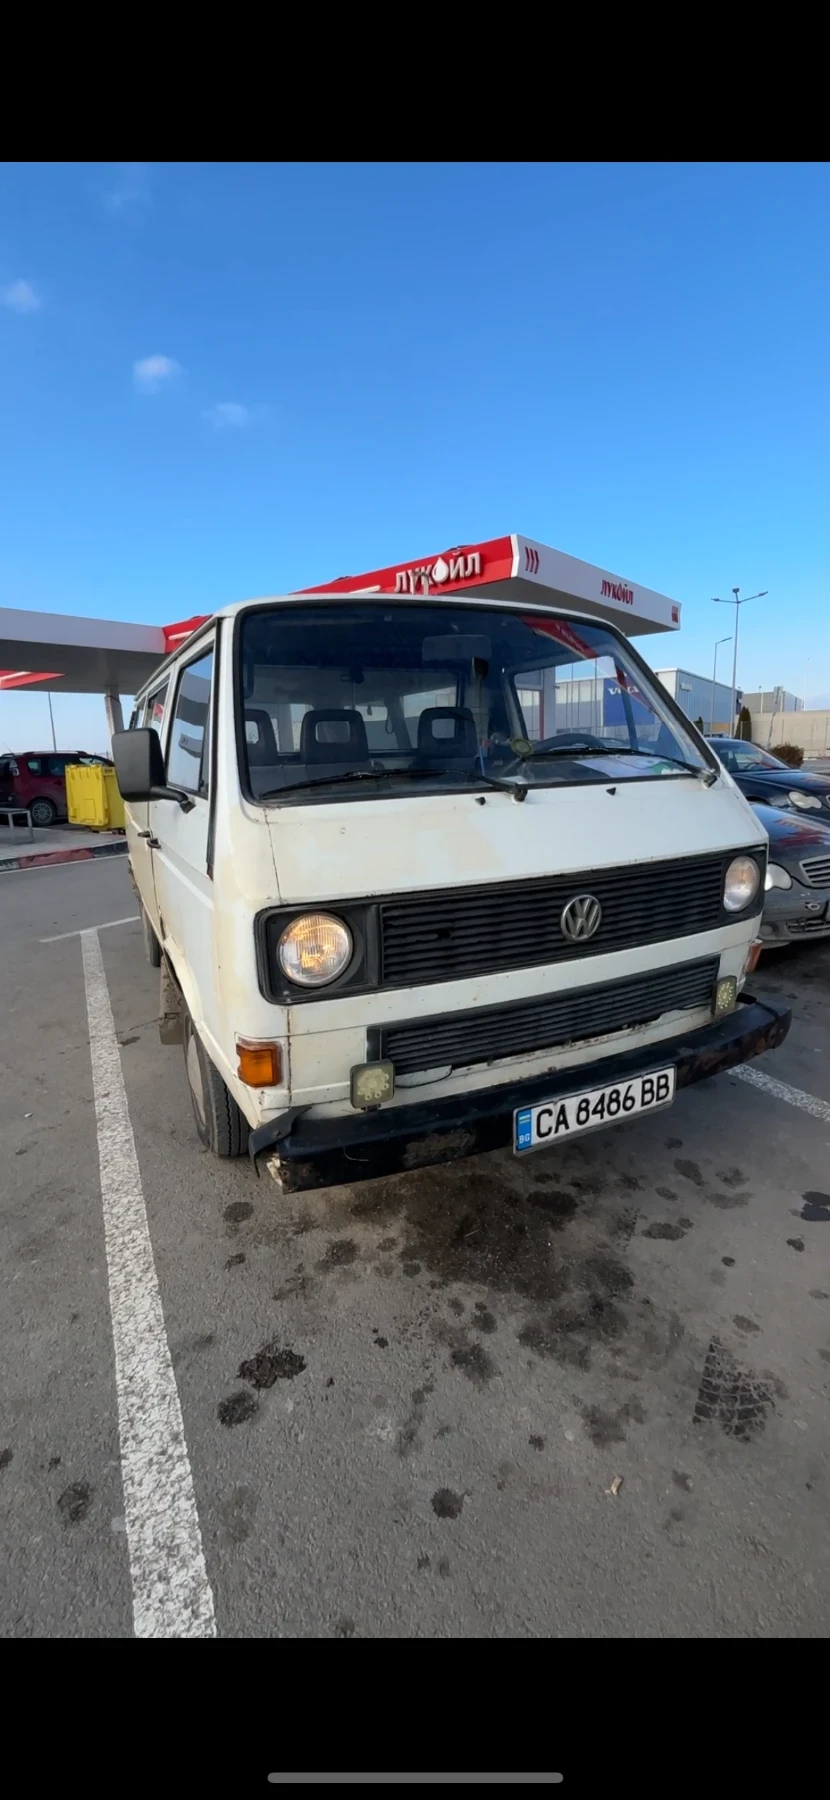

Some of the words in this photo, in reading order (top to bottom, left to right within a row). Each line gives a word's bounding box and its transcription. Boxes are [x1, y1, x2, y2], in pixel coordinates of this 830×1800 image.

[394, 552, 480, 595] ЛУКОЙЛ
[601, 579, 633, 605] ЛУКОЙЛ
[536, 1104, 570, 1139] CA
[576, 1084, 635, 1126] 8486
[641, 1074, 670, 1107] BB
[519, 1133, 530, 1144] BG
